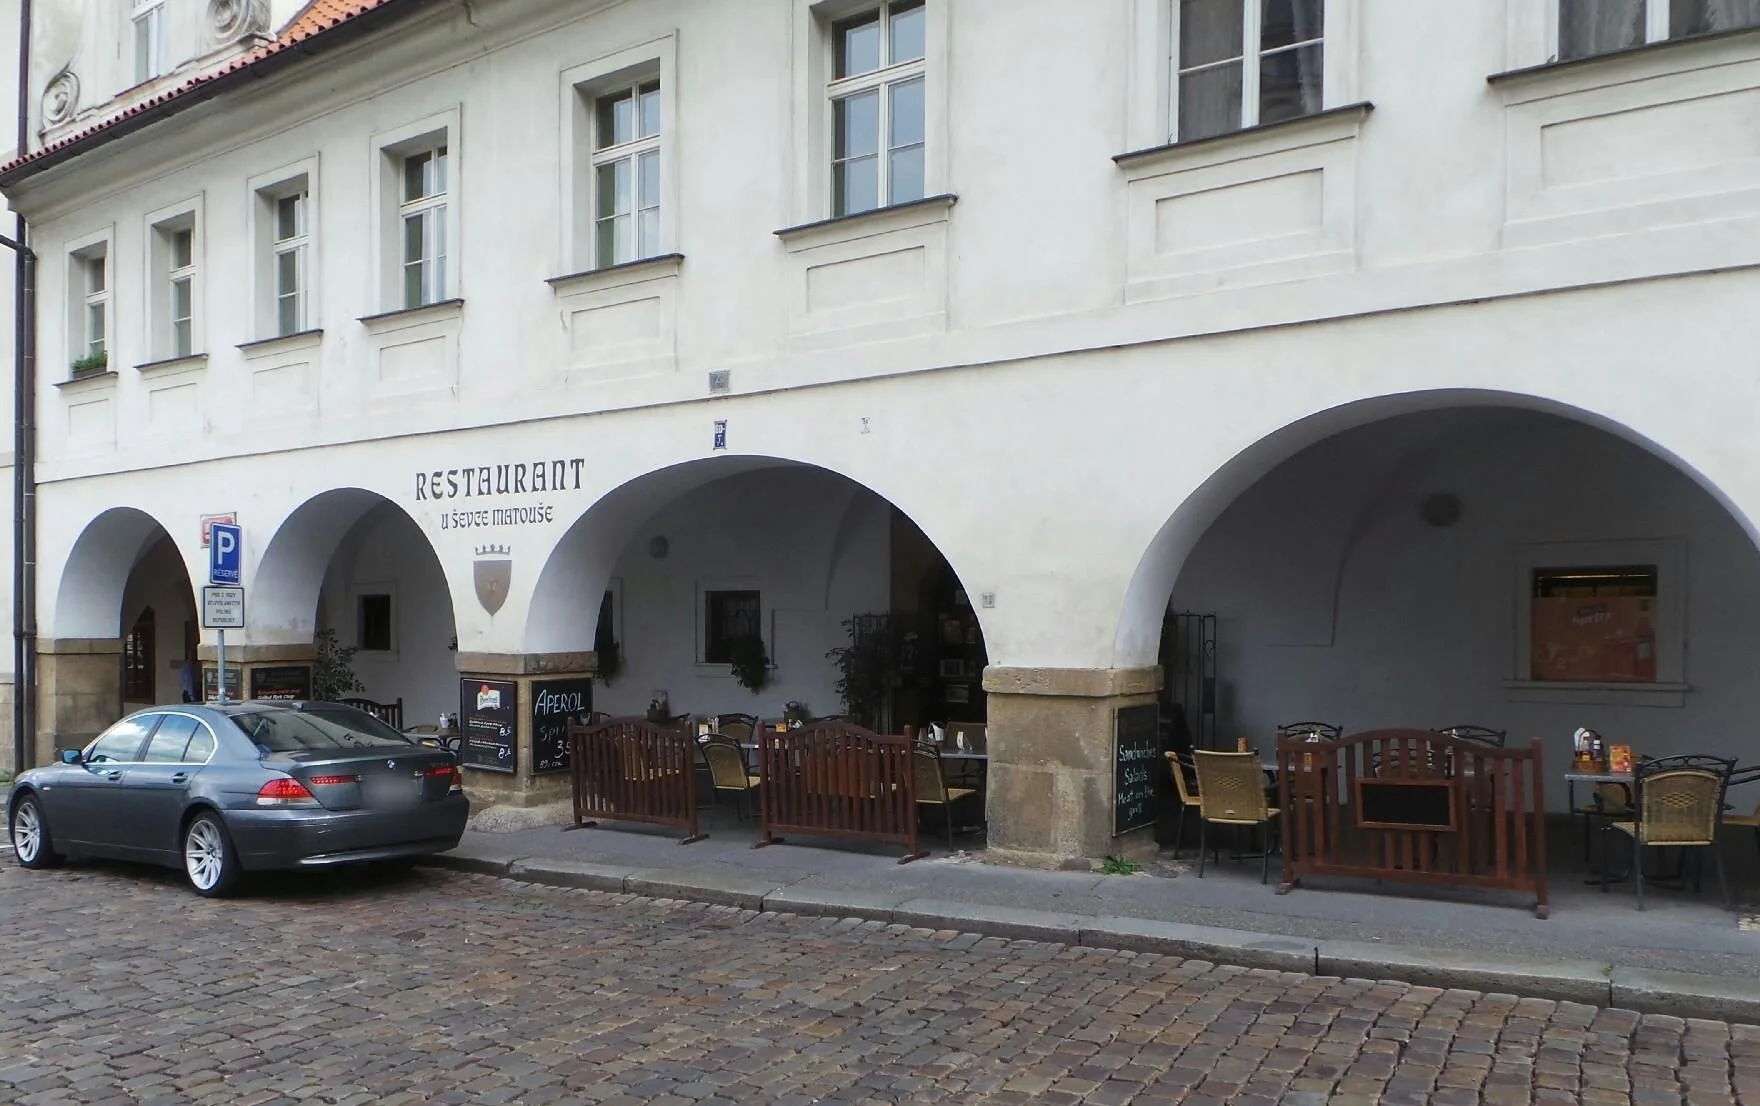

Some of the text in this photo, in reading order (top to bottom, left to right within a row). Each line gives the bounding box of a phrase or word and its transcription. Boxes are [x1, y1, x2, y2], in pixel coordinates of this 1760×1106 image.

[415, 457, 585, 501] RESTAURANT
[441, 513, 449, 530] U
[492, 502, 554, 526] MATOUŠE
[217, 530, 236, 565] P
[534, 688, 585, 716] APEROL
